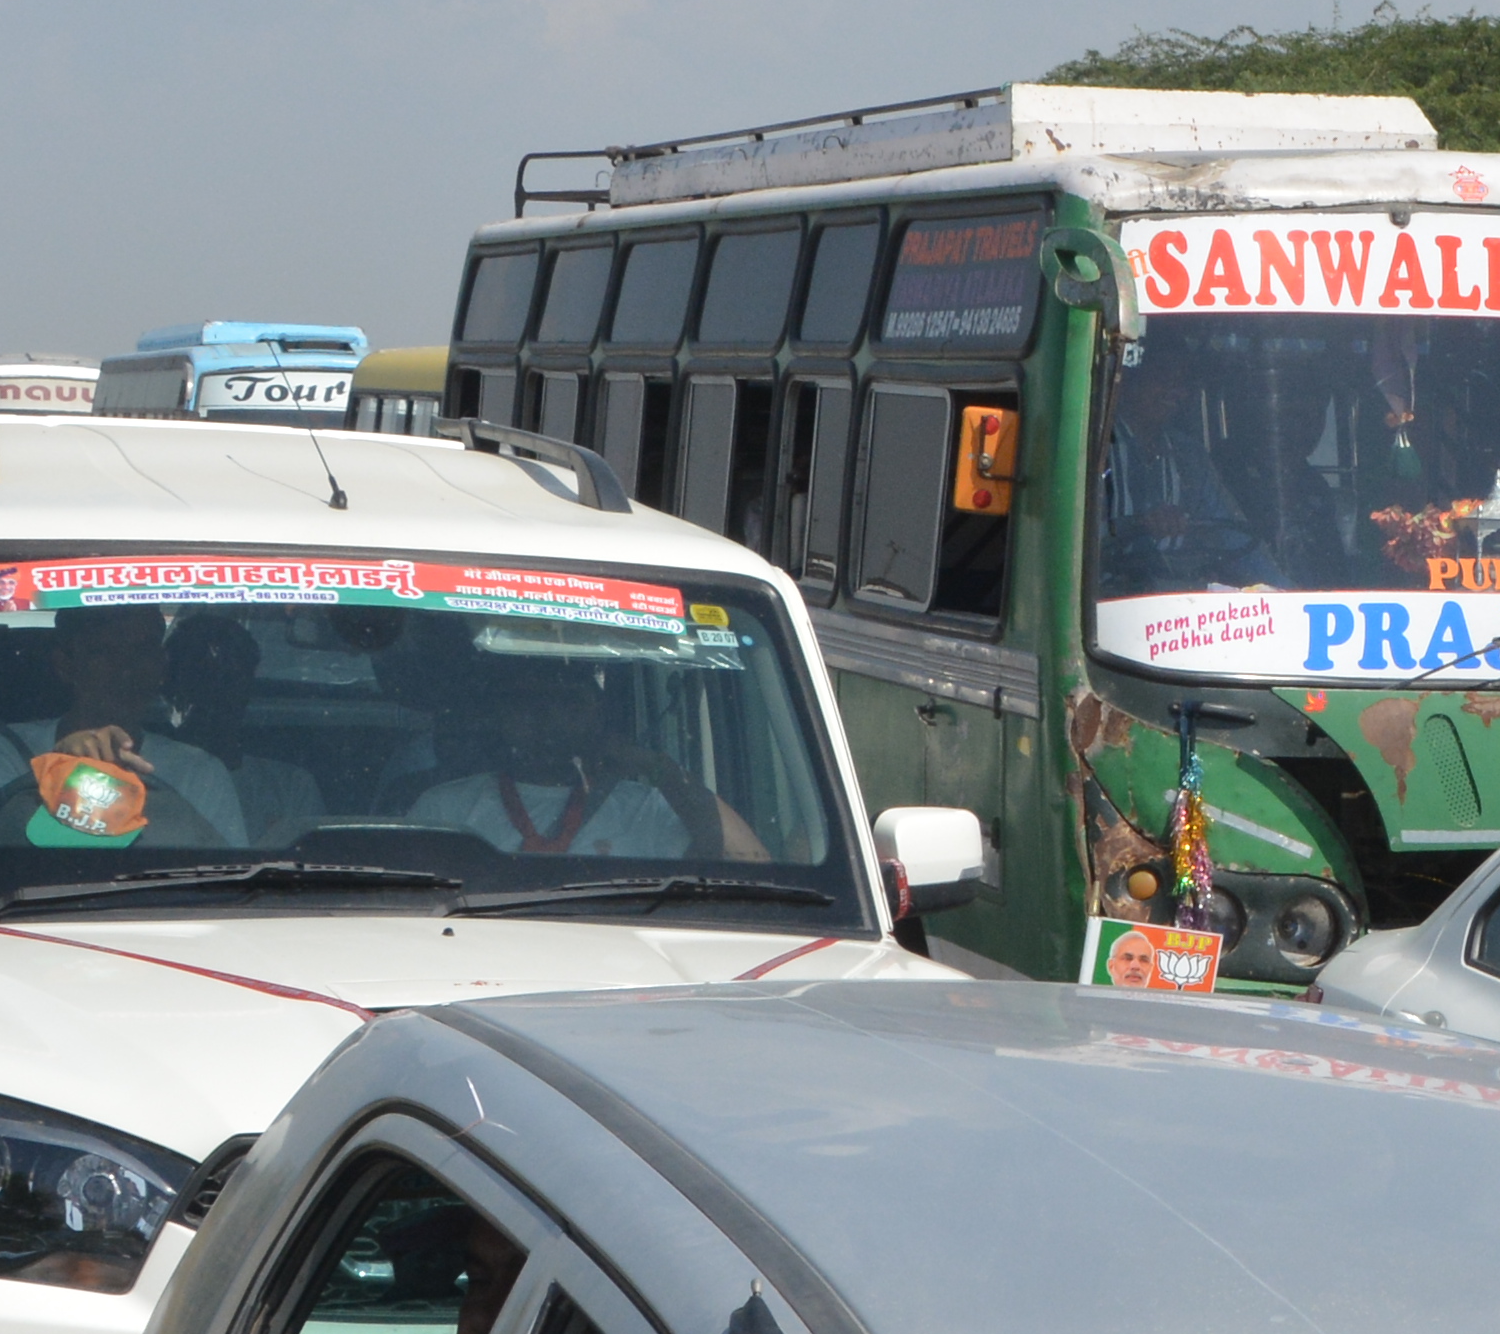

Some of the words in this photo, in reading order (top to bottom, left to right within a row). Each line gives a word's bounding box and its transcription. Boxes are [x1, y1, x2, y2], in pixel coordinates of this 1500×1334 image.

[1145, 617, 1191, 641] prem
[1197, 597, 1271, 629] prakash
[1149, 629, 1214, 661] prabhu
[1220, 617, 1275, 644] dayal
[1164, 931, 1213, 951] BJP
